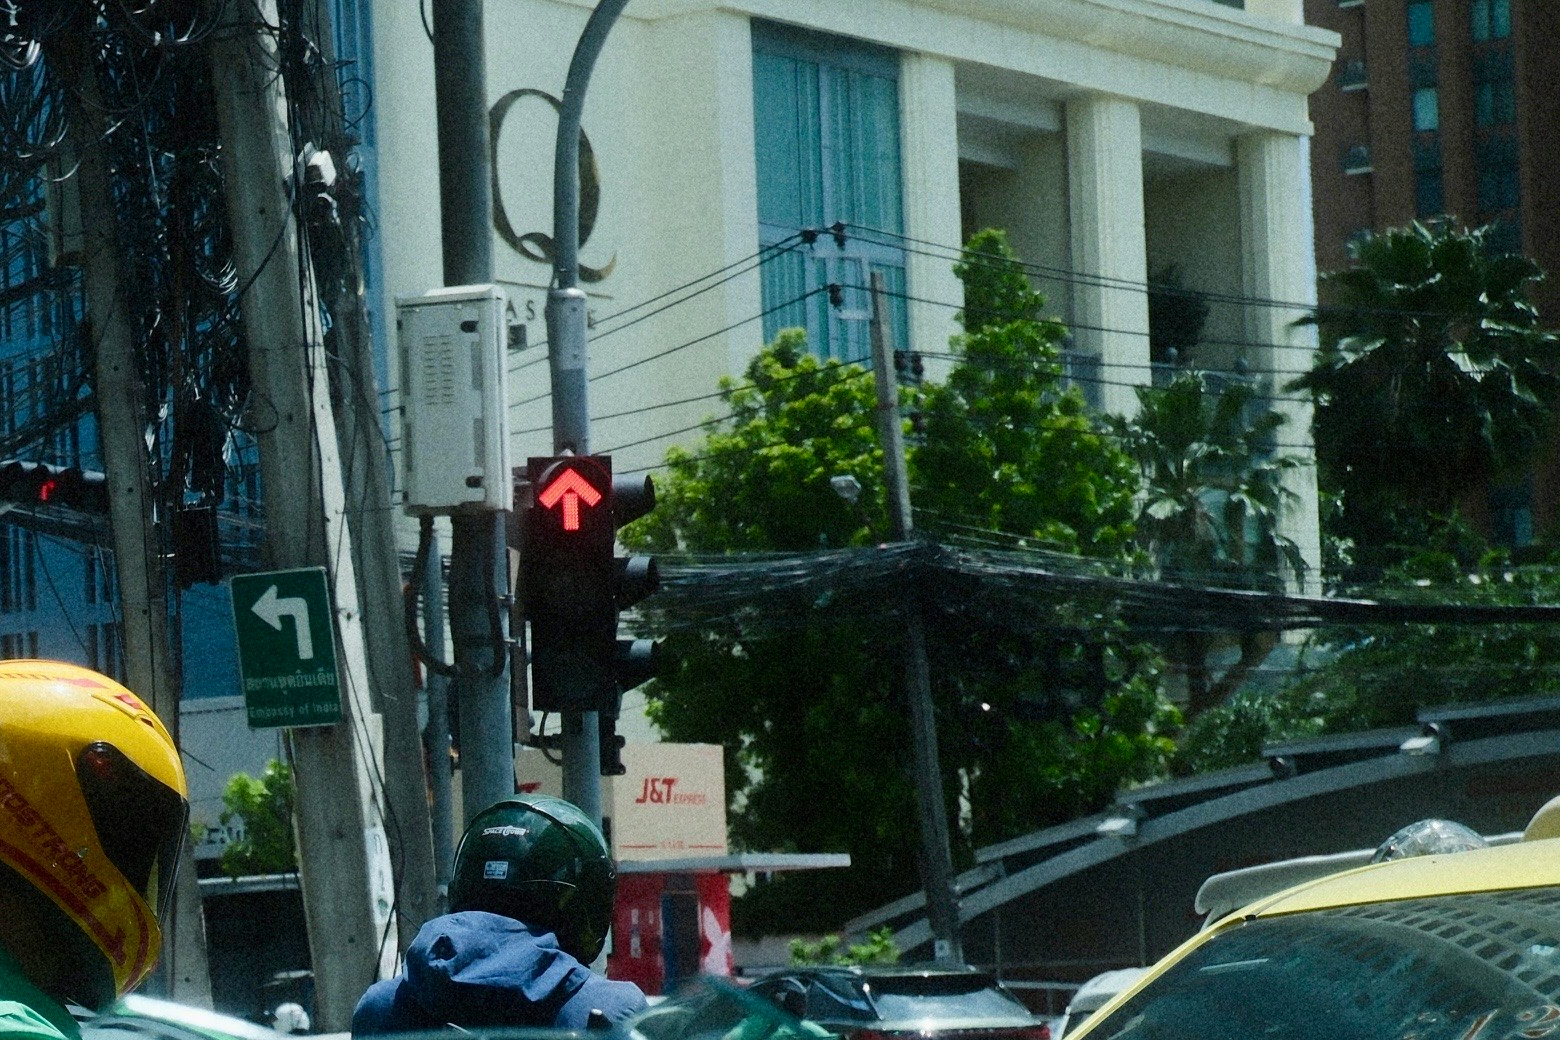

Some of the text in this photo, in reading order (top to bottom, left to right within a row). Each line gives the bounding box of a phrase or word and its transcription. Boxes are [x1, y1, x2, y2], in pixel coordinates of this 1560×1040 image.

[249, 701, 339, 719] Embassy of India
[635, 777, 678, 804] J&T
